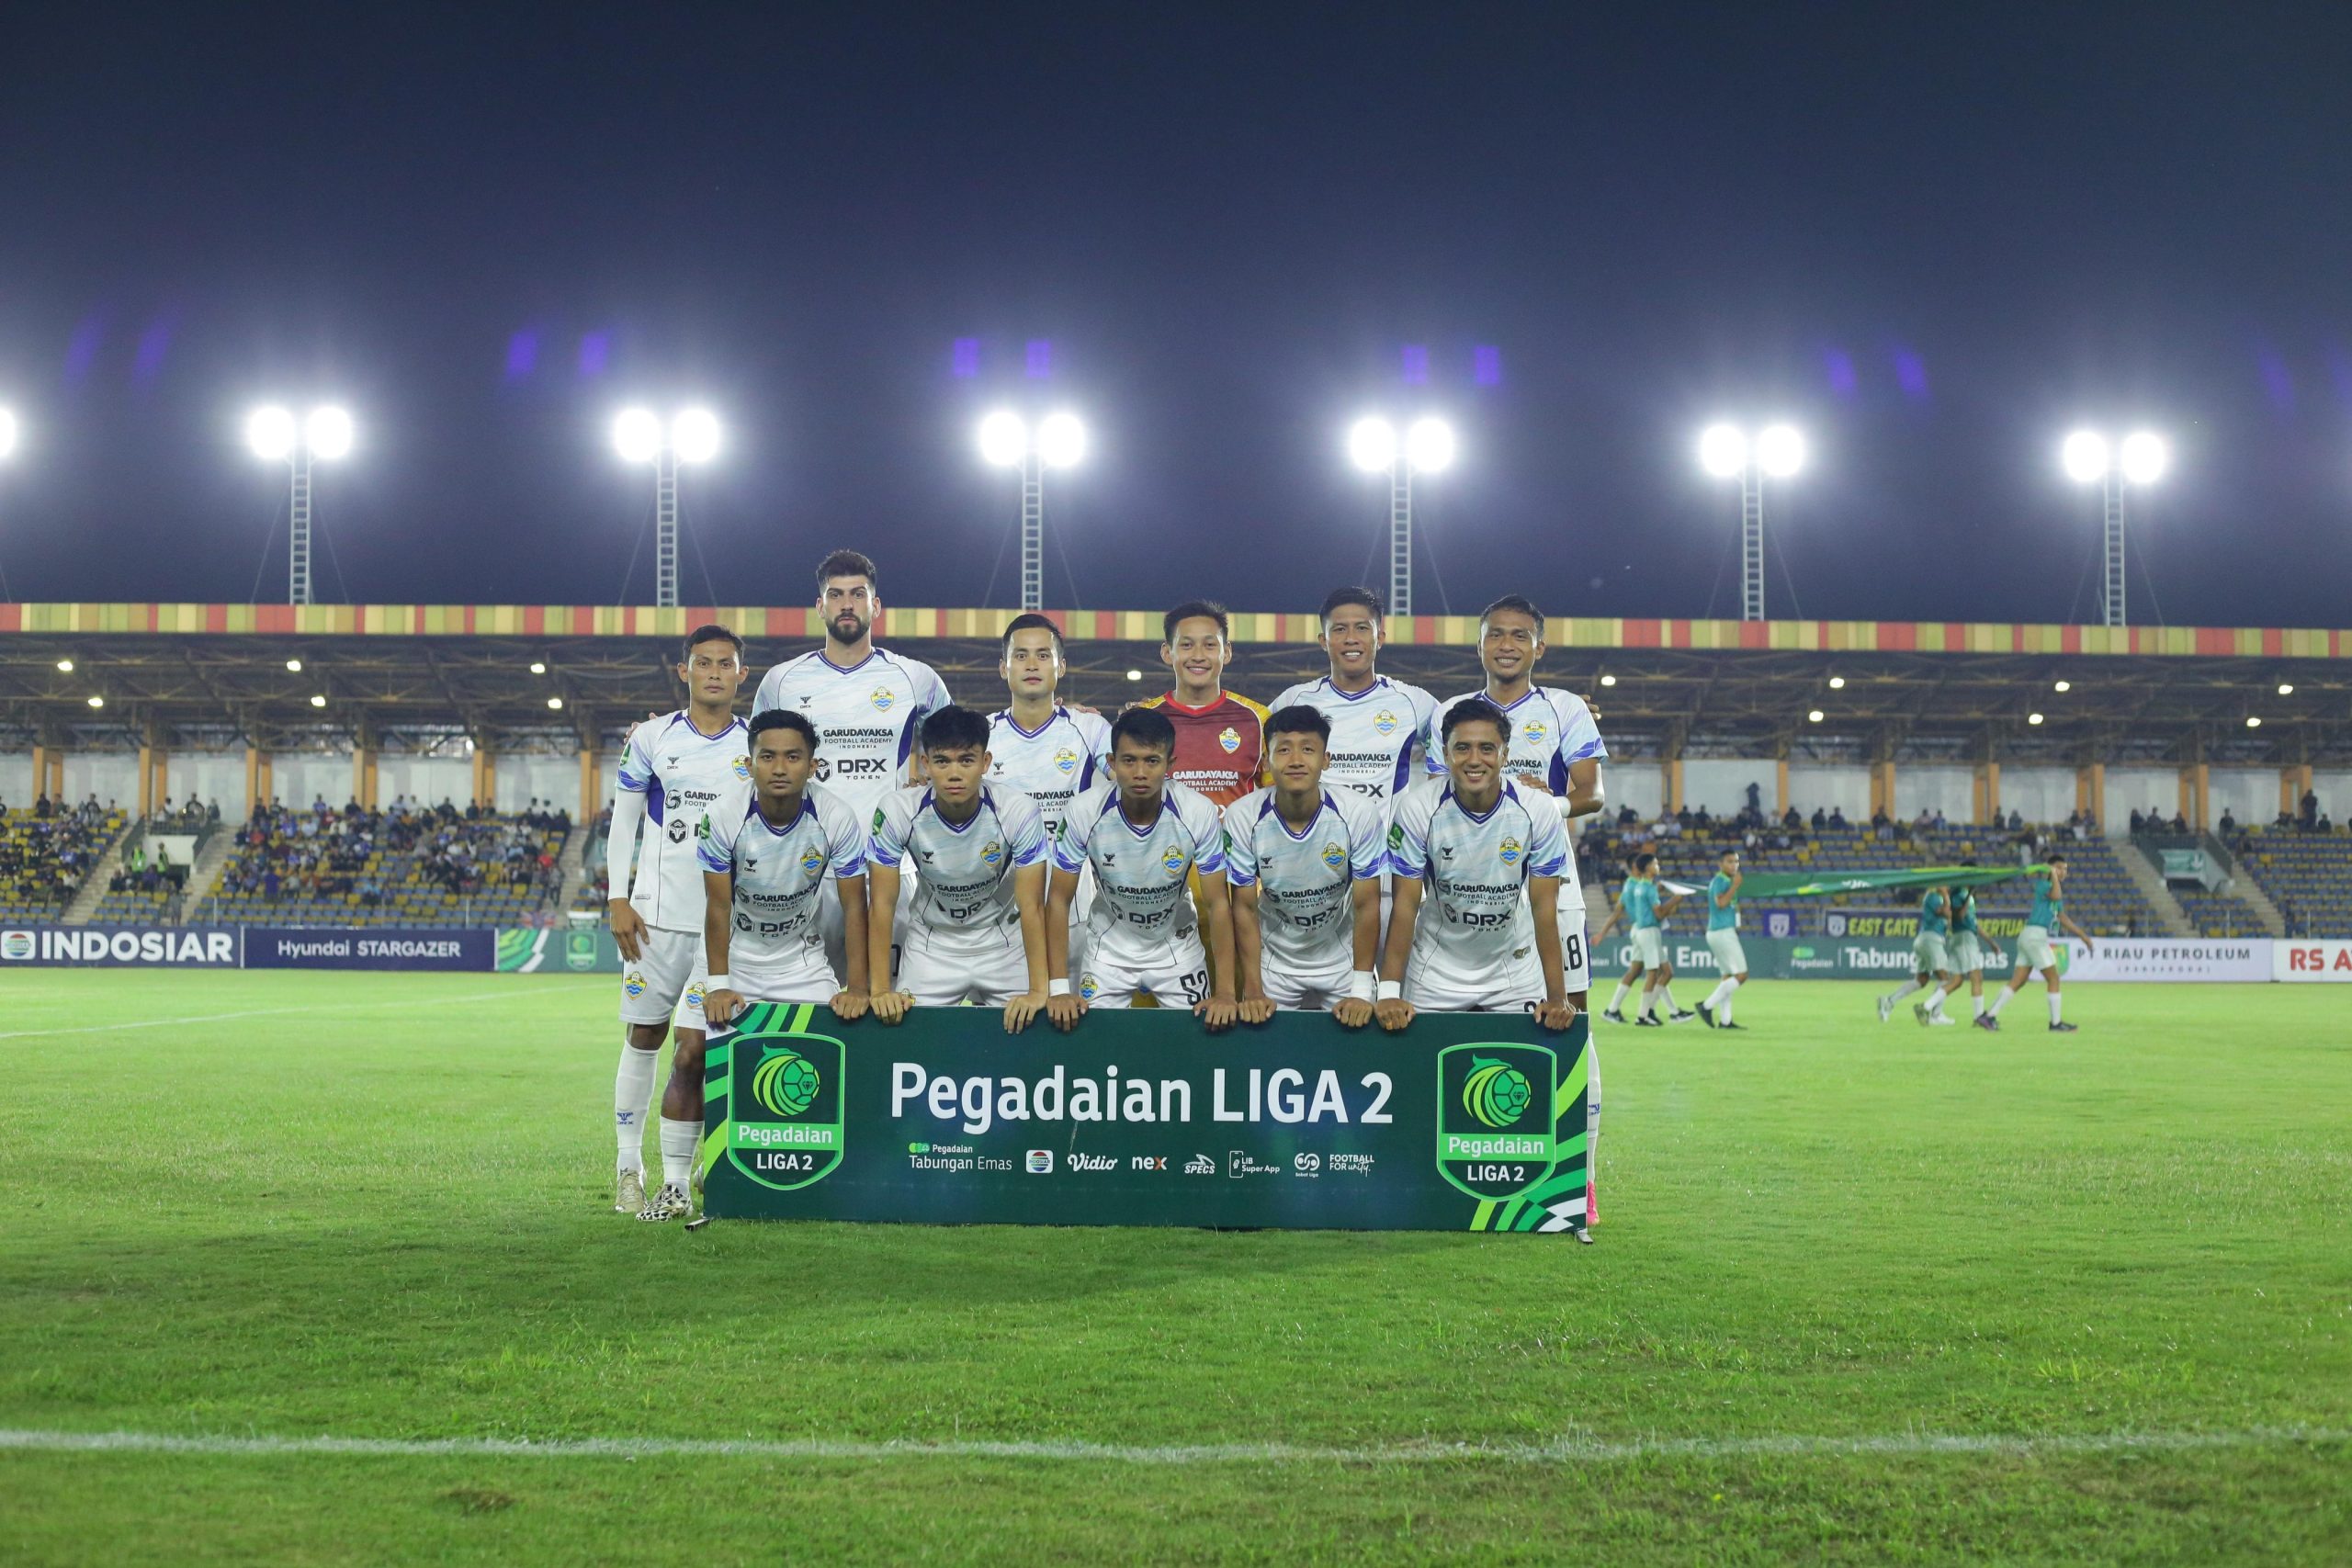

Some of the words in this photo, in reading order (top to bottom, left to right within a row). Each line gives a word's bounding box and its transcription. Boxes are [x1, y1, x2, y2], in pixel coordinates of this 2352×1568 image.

[823, 728, 894, 737] GARUDAYAKSA
[837, 758, 888, 773] DRX
[1329, 753, 1392, 762] ARUDAYAKSA
[1504, 759, 1543, 768] DAYAKSA
[1172, 771, 1238, 780] GARUDAYAKSA
[1342, 784, 1384, 798] RX
[1116, 879, 1183, 895] GARUDAYAKSA
[1453, 883, 1520, 894] GARUDAYAKSA
[1453, 891, 1487, 900] FOOTBALL
[1487, 891, 1520, 901] ACADEMY
[949, 897, 991, 919] DR
[1129, 902, 1176, 924] DRX
[1295, 900, 1339, 927] DRX
[760, 909, 807, 933] DRX
[1462, 908, 1512, 927] DRX
[1849, 917, 1883, 936] EAST
[1883, 917, 1918, 937] GATE
[41, 931, 233, 962] INDOSIAR
[277, 939, 350, 959] Hyundai
[356, 940, 461, 957] STARGAZER
[1562, 933, 1582, 971] 8
[2103, 947, 2144, 960] RIAU
[2151, 947, 2251, 960] PETROLEUM
[1845, 946, 1918, 974] Tabung
[2290, 947, 2325, 971] RS
[2334, 947, 2352, 971] A
[1179, 970, 1211, 1006] 52
[891, 1062, 1192, 1135] Pegadaian
[1213, 1067, 1349, 1124] LIGA
[1360, 1071, 1394, 1124] 2
[738, 1124, 832, 1146] Pegadaian
[932, 1144, 973, 1155] Pegadaian
[1448, 1136, 1544, 1158] Pegadaian
[756, 1153, 799, 1170] LIGA
[802, 1155, 813, 1170] 2
[909, 1155, 973, 1173] Tabungan
[978, 1156, 1012, 1170] Emas
[1067, 1152, 1118, 1172] Vidio
[1131, 1156, 1168, 1170] nex
[1241, 1156, 1253, 1165] LIB
[1329, 1154, 1375, 1163] FOOTBALL
[1329, 1162, 1347, 1171] FOR
[1184, 1165, 1216, 1175] SPECS
[1241, 1165, 1264, 1174] Super
[1264, 1166, 1281, 1174] App
[1467, 1165, 1510, 1181] LIGA
[1514, 1166, 1525, 1181] 2
